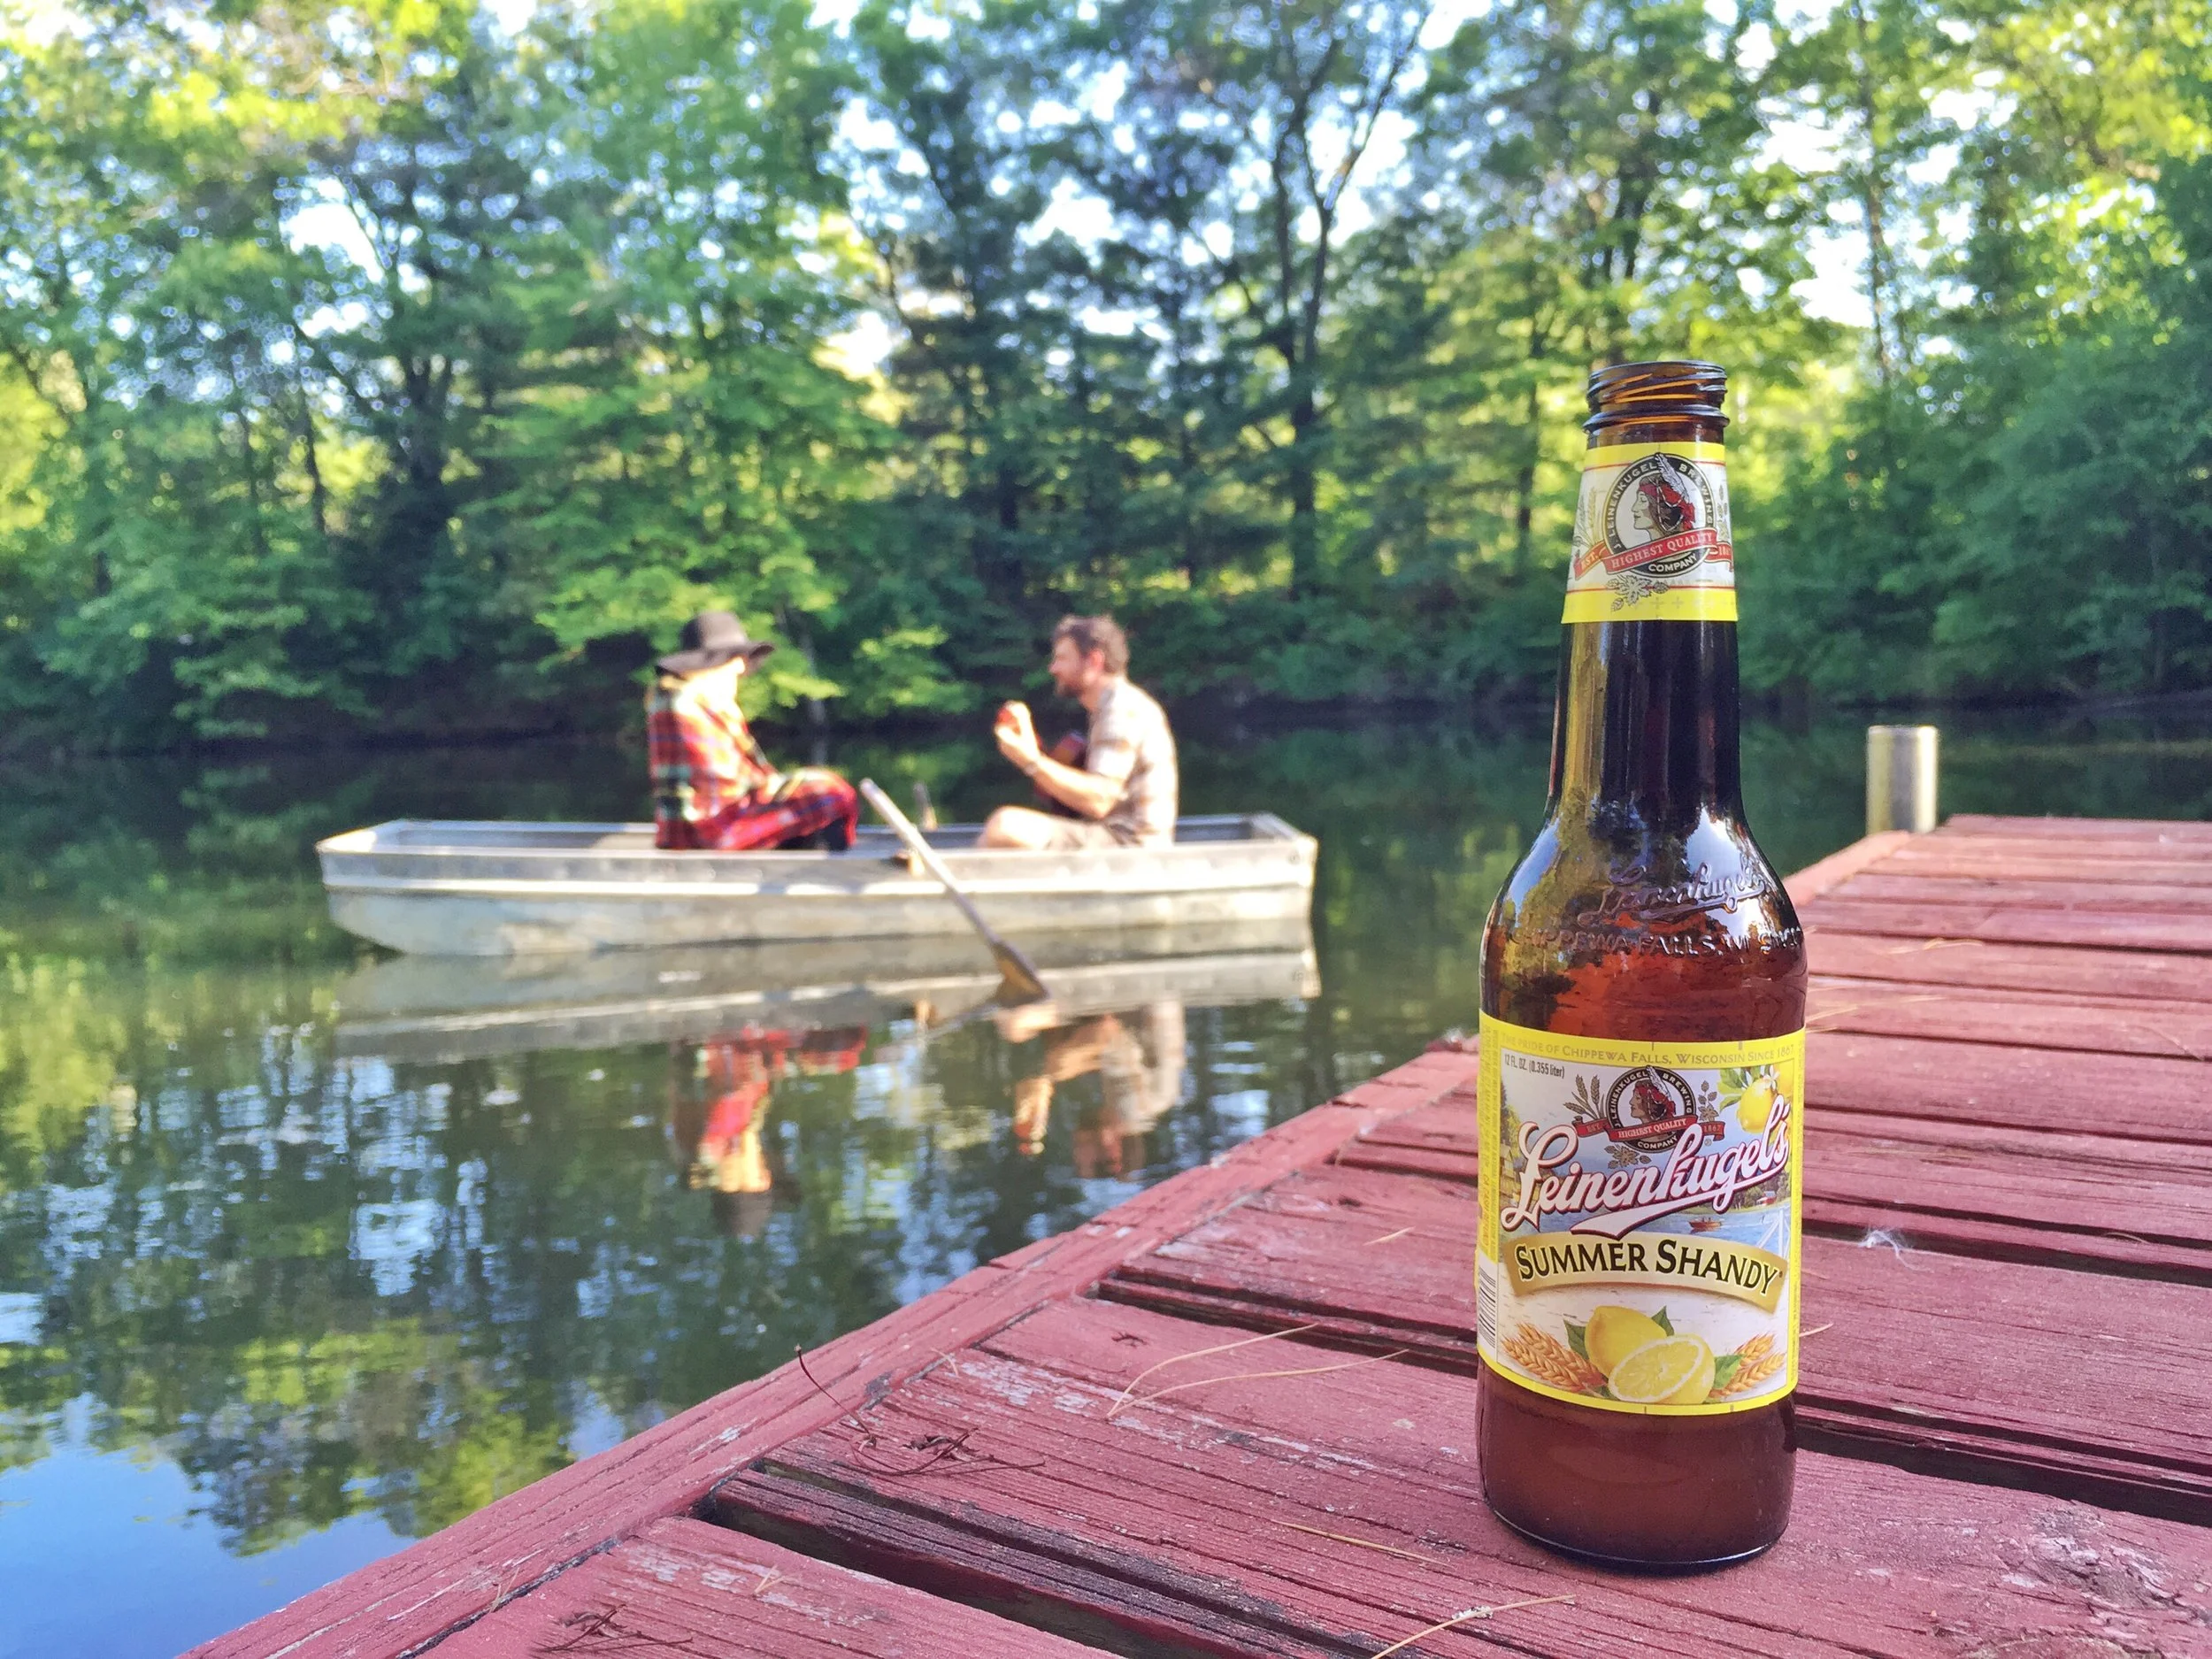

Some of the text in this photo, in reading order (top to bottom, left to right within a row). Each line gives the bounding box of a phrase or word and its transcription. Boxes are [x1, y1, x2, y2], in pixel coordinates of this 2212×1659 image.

[1607, 462, 1657, 538] LEINENKUGEL
[1678, 463, 1713, 524] BREWING
[1611, 531, 1714, 568] HIGHEST QUALITY
[1648, 554, 1697, 573] COMPANY
[1546, 1043, 1560, 1054] OF
[1562, 1045, 1627, 1063] CHIPPEWA
[1631, 1051, 1672, 1064] FALLS,
[1676, 1053, 1745, 1064] WISCONSIN
[1747, 1049, 1774, 1062] SINCE
[1776, 1044, 1794, 1057] 1867
[1529, 1060, 1549, 1074] (0.355
[1549, 1064, 1565, 1079] liter)
[1611, 1071, 1648, 1119] LEINENKUGEL
[1662, 1072, 1693, 1114] BREWING
[1617, 1118, 1687, 1139] HIGHEST QUALITY
[1637, 1135, 1679, 1149] COMPANY
[1501, 1094, 1792, 1236] Leinenkugel's
[1516, 1239, 1779, 1295] SUMMER SHANDY
